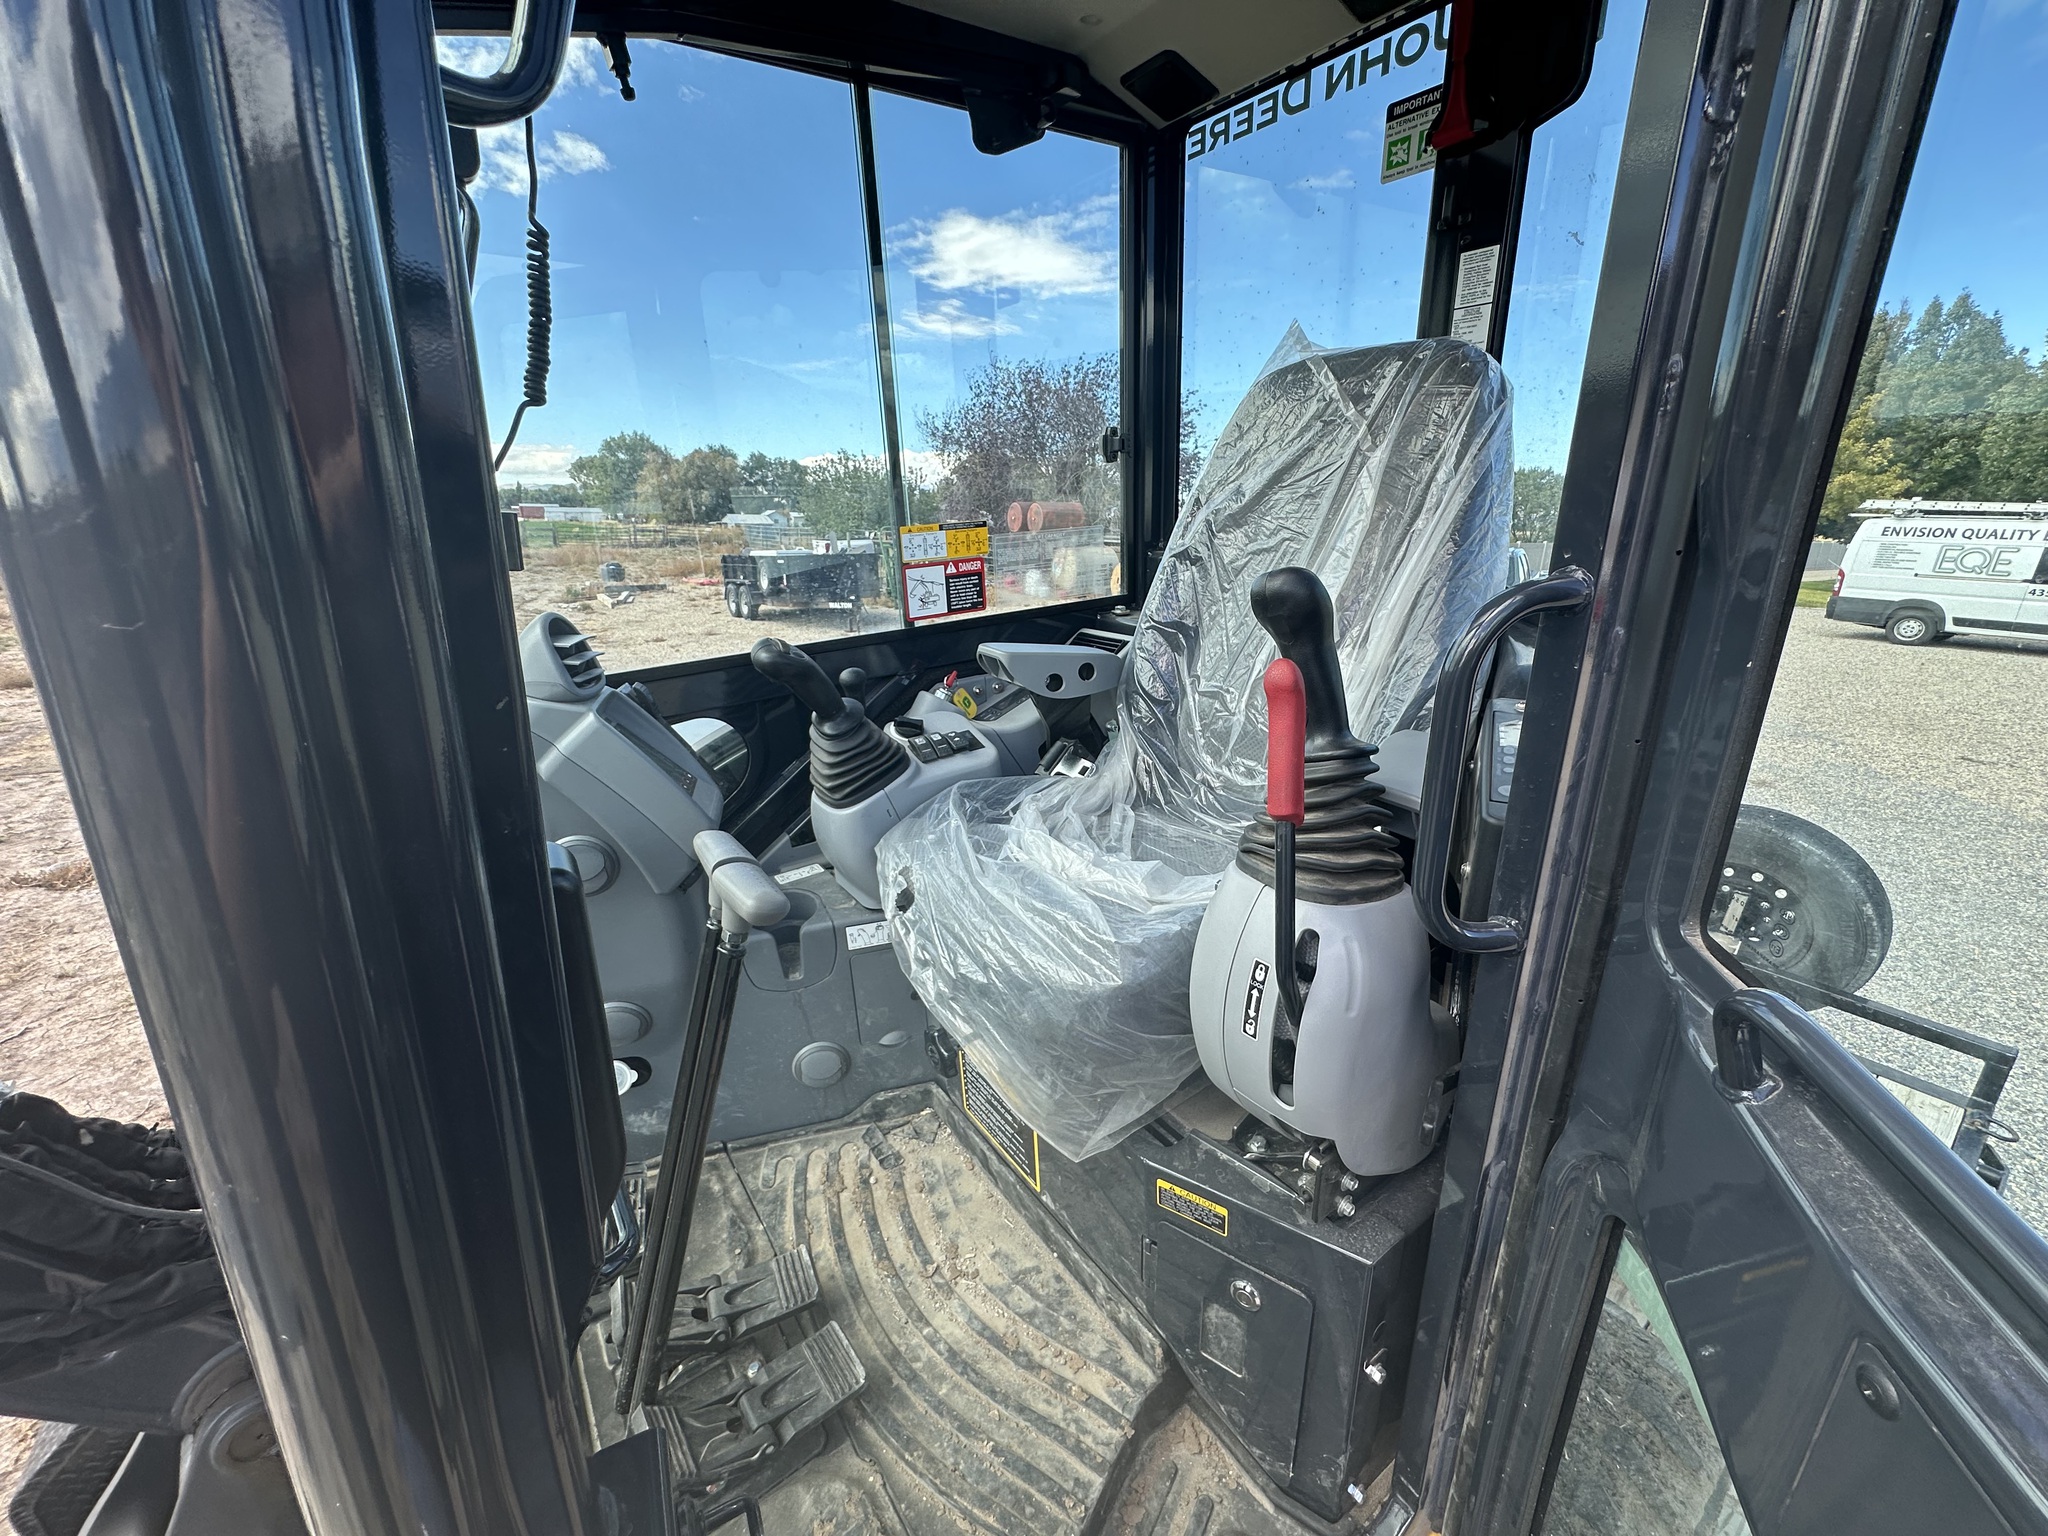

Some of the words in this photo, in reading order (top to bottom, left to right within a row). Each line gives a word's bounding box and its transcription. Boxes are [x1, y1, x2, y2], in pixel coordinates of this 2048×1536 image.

[1393, 89, 1443, 116] IMPORTAN
[1387, 110, 1429, 131] ALTERNATIVE
[1880, 526, 1958, 538] ENVISION
[1961, 527, 2041, 541] QUALITY
[958, 560, 982, 572] DANGER
[1932, 544, 2021, 577] EQE
[1250, 979, 1265, 990] LOCK
[1179, 1189, 1217, 1210] CAUTION
